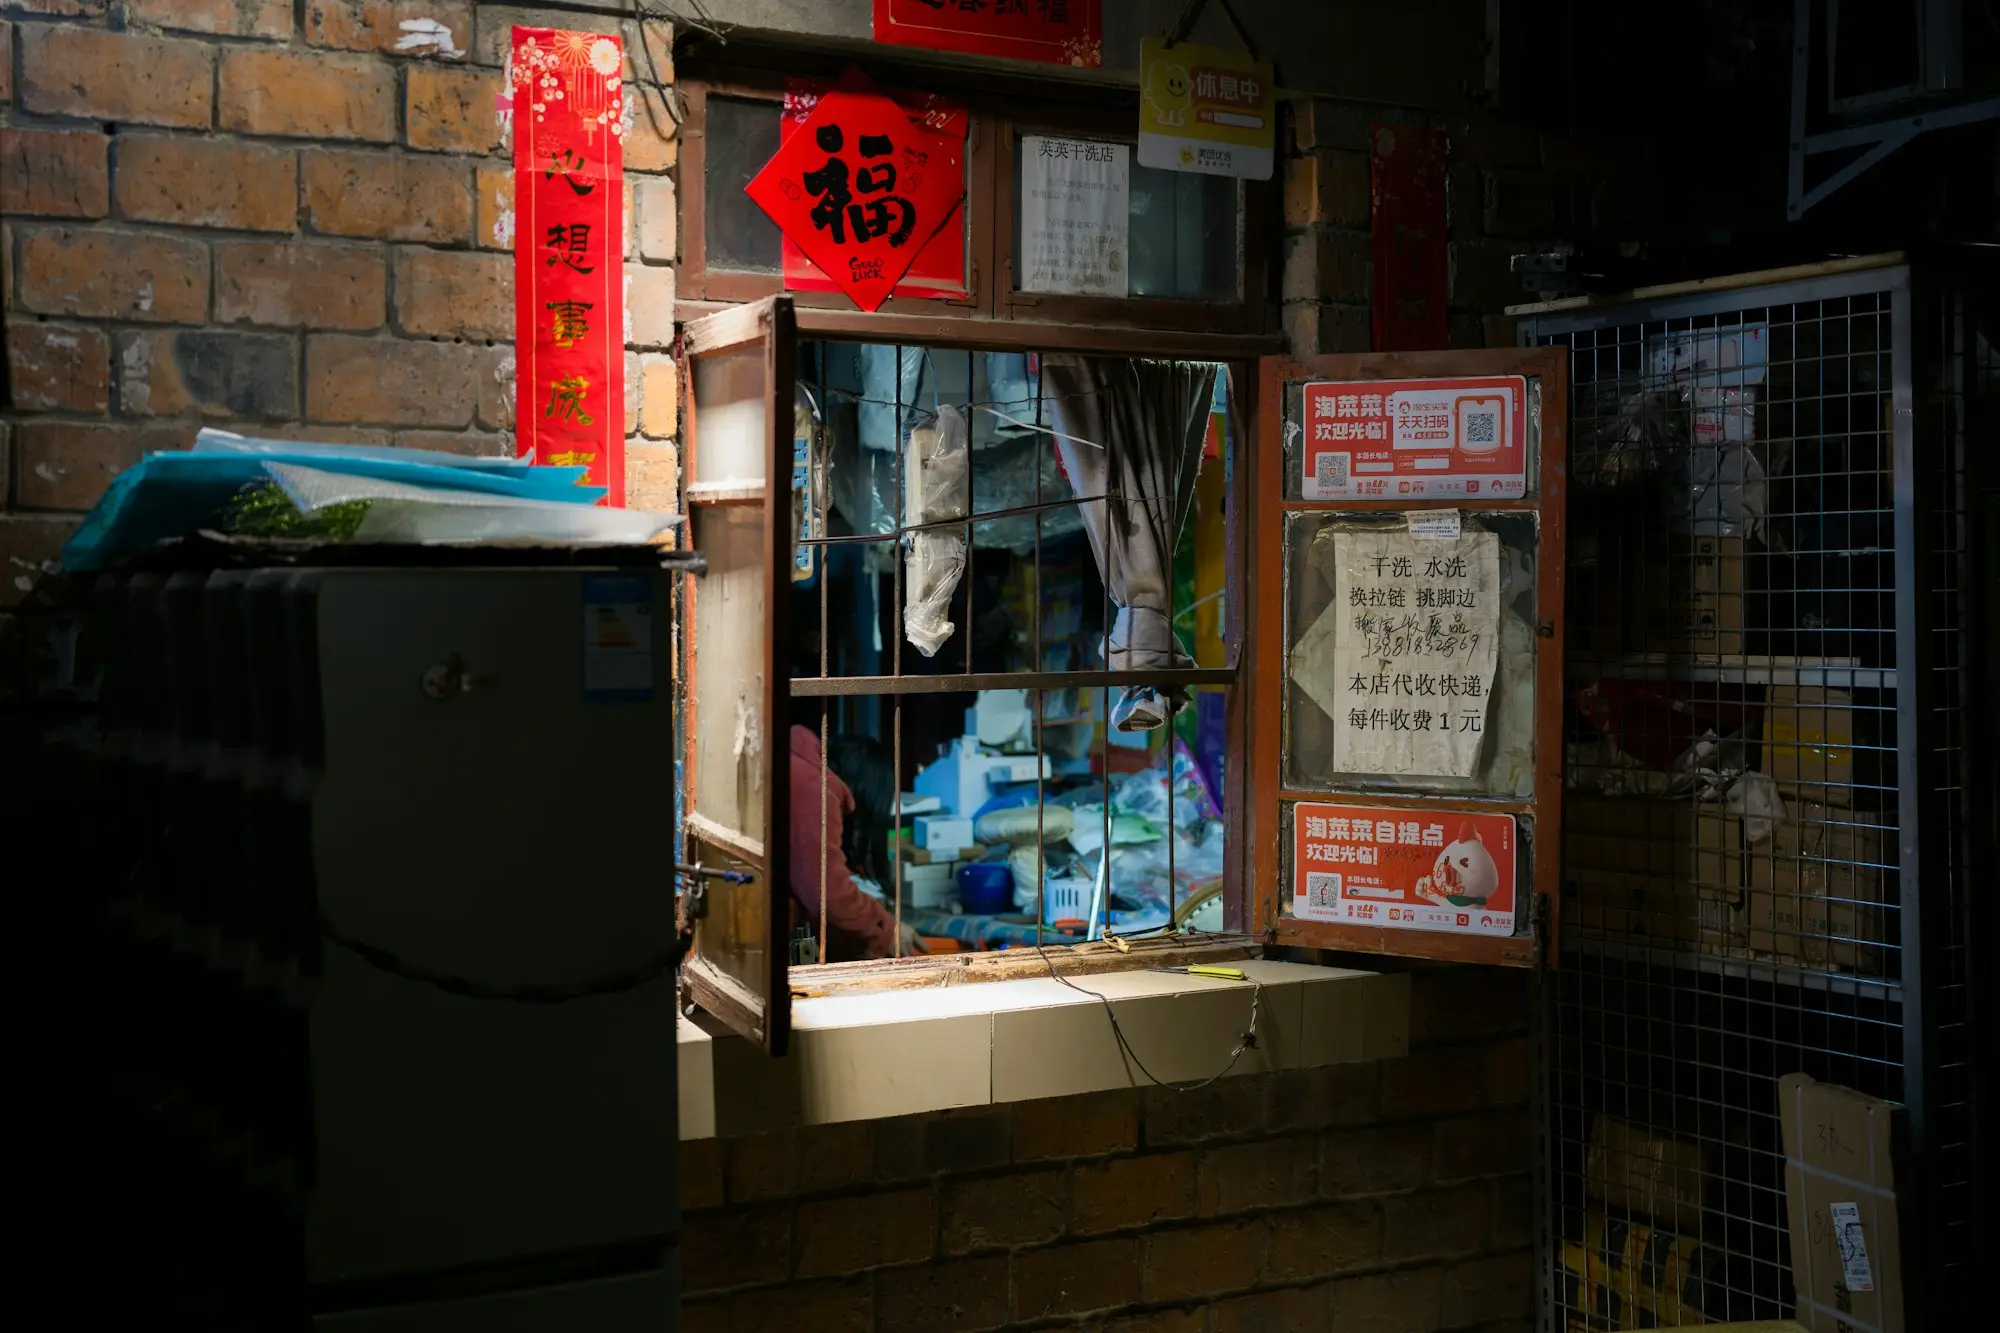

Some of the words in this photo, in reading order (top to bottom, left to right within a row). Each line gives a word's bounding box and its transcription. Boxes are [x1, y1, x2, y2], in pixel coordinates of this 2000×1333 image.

[1196, 71, 1260, 104] 休息中
[1038, 140, 1114, 163] 英英干洗店
[803, 123, 917, 248] 福
[1315, 421, 1387, 440] 欢迎光临!
[1398, 414, 1449, 429] 天天扫码
[1370, 556, 1412, 578] 干洗
[1424, 556, 1467, 578] 水洗
[1350, 587, 1406, 608] 换拉链
[1416, 587, 1475, 608] 挑脚边
[1348, 673, 1489, 697] 本店代收快递，
[1305, 815, 1444, 847] 淘菜菜自提点
[1306, 843, 1378, 865] 欢迎光临!
